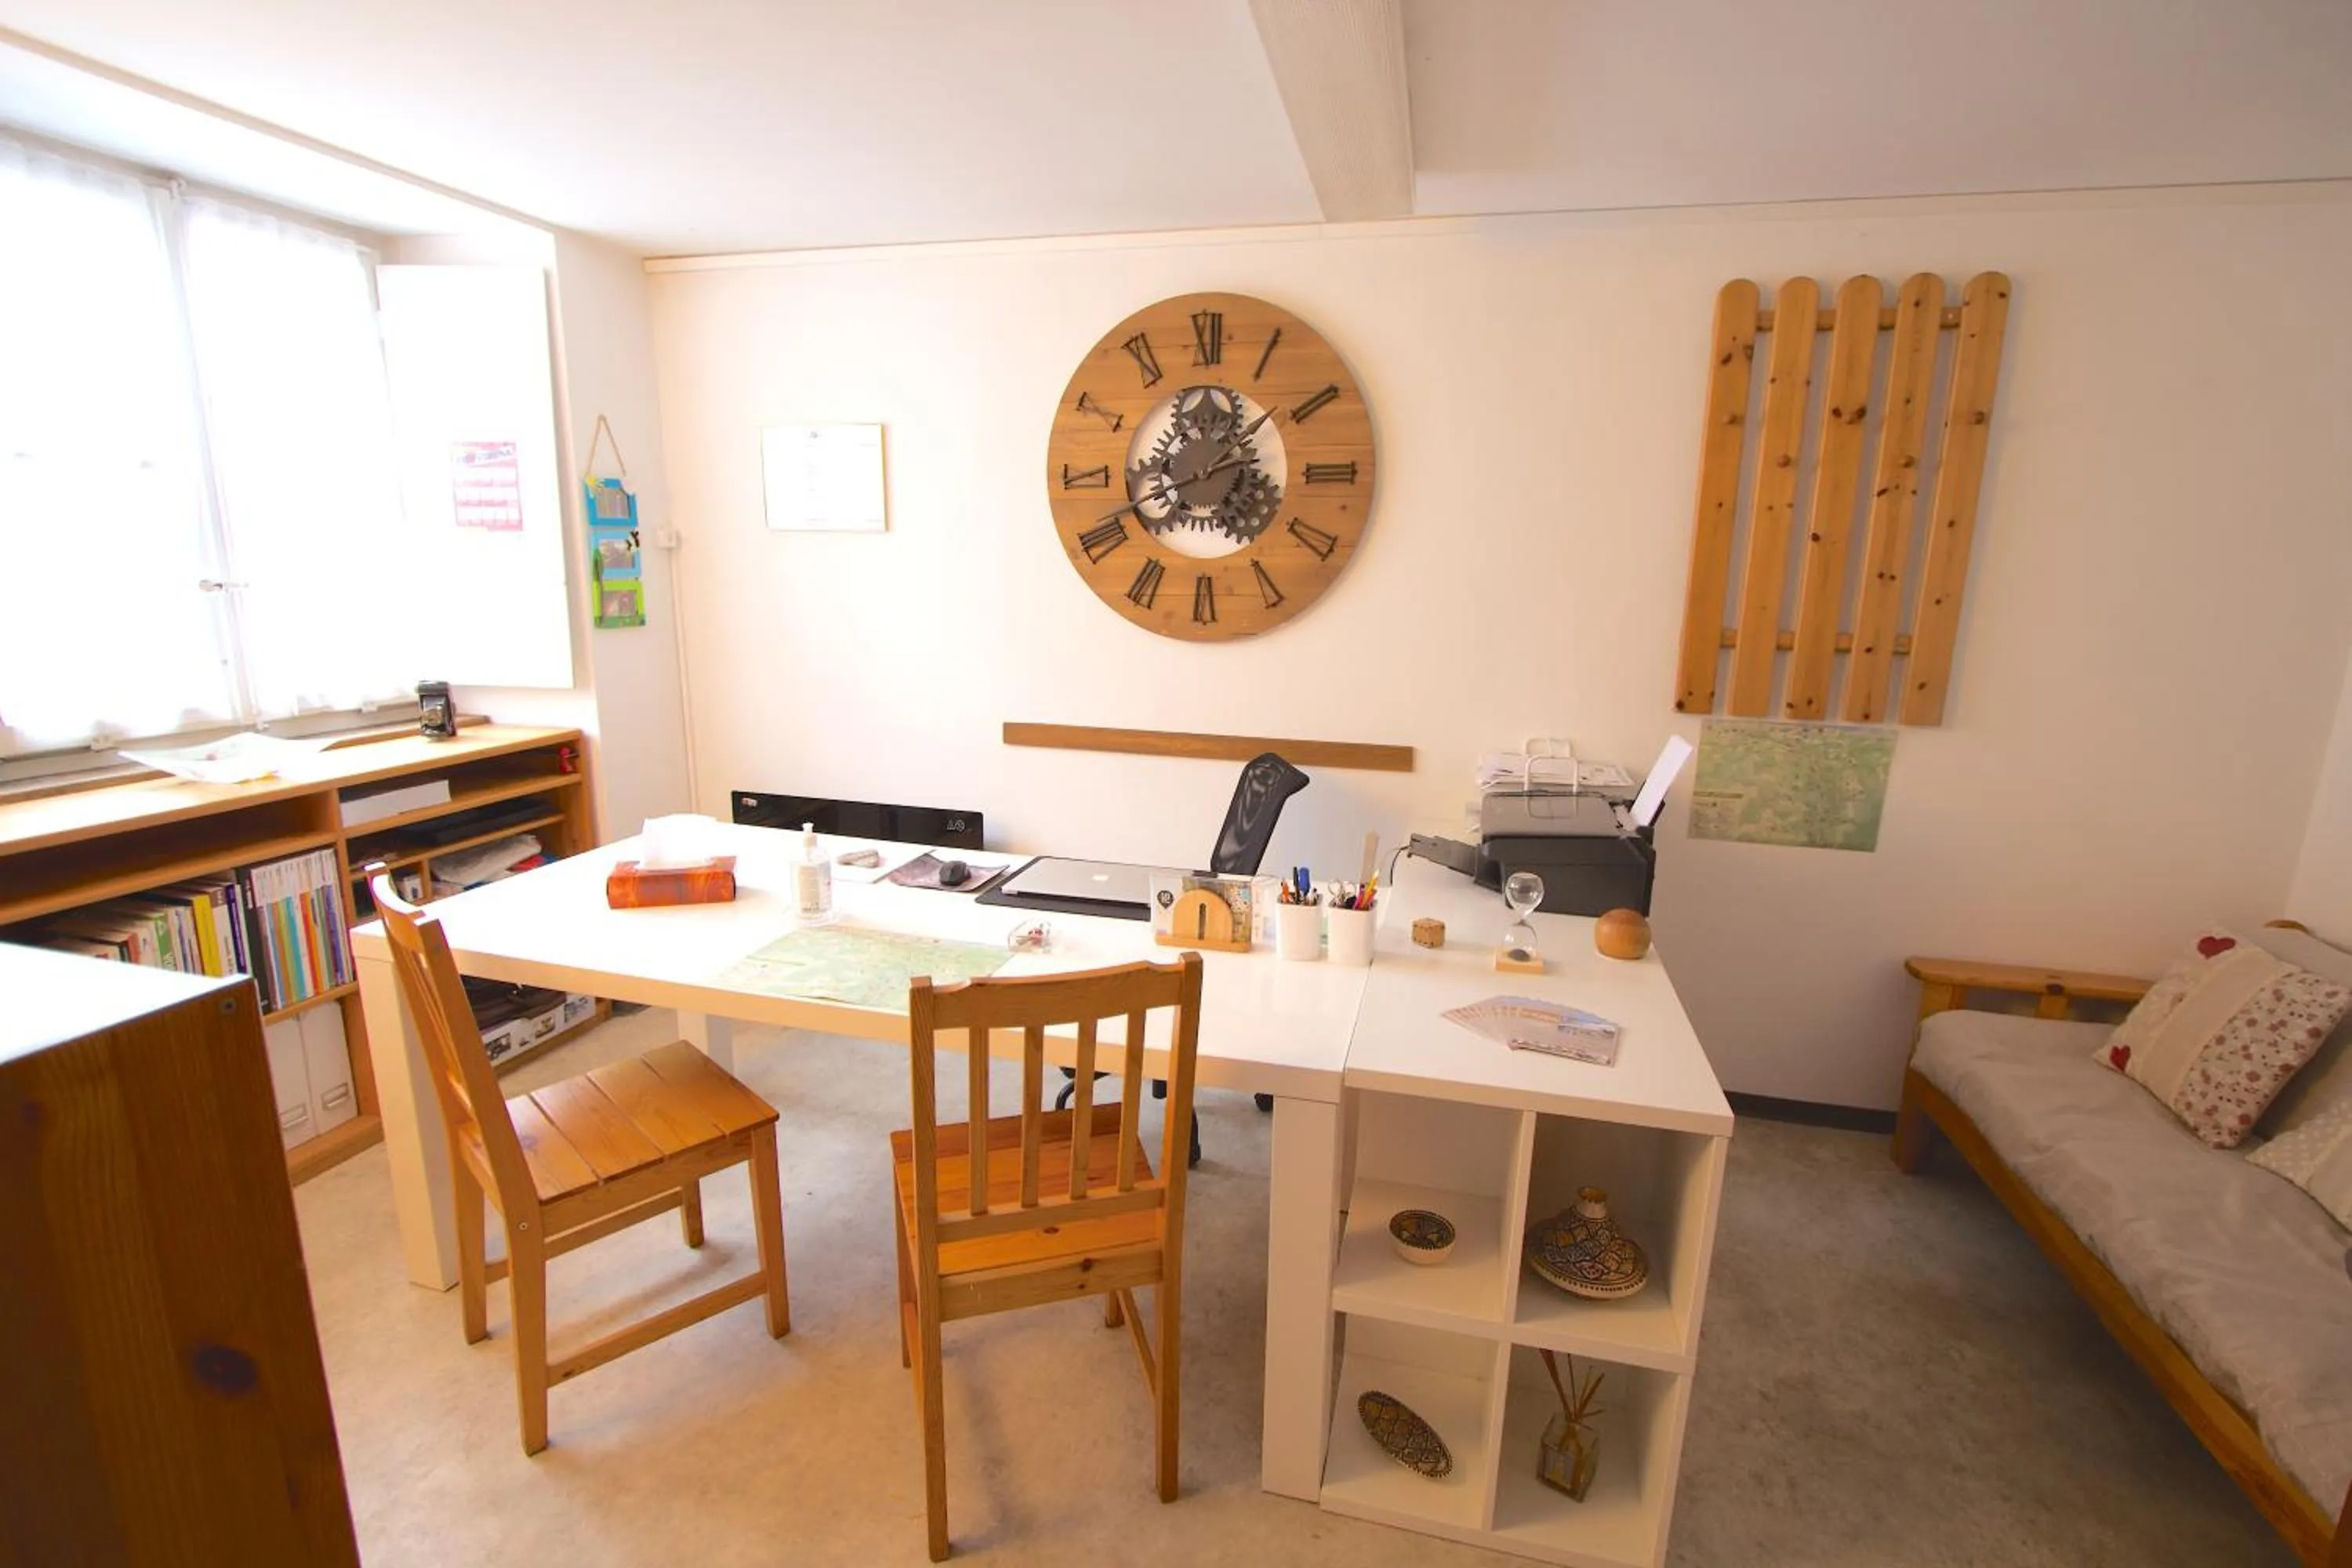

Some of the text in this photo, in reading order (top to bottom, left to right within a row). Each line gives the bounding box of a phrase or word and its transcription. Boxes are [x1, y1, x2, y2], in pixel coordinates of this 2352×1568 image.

[1191, 309, 1222, 368] XII
[1290, 383, 1339, 425] II
[1302, 460, 1358, 485] III
